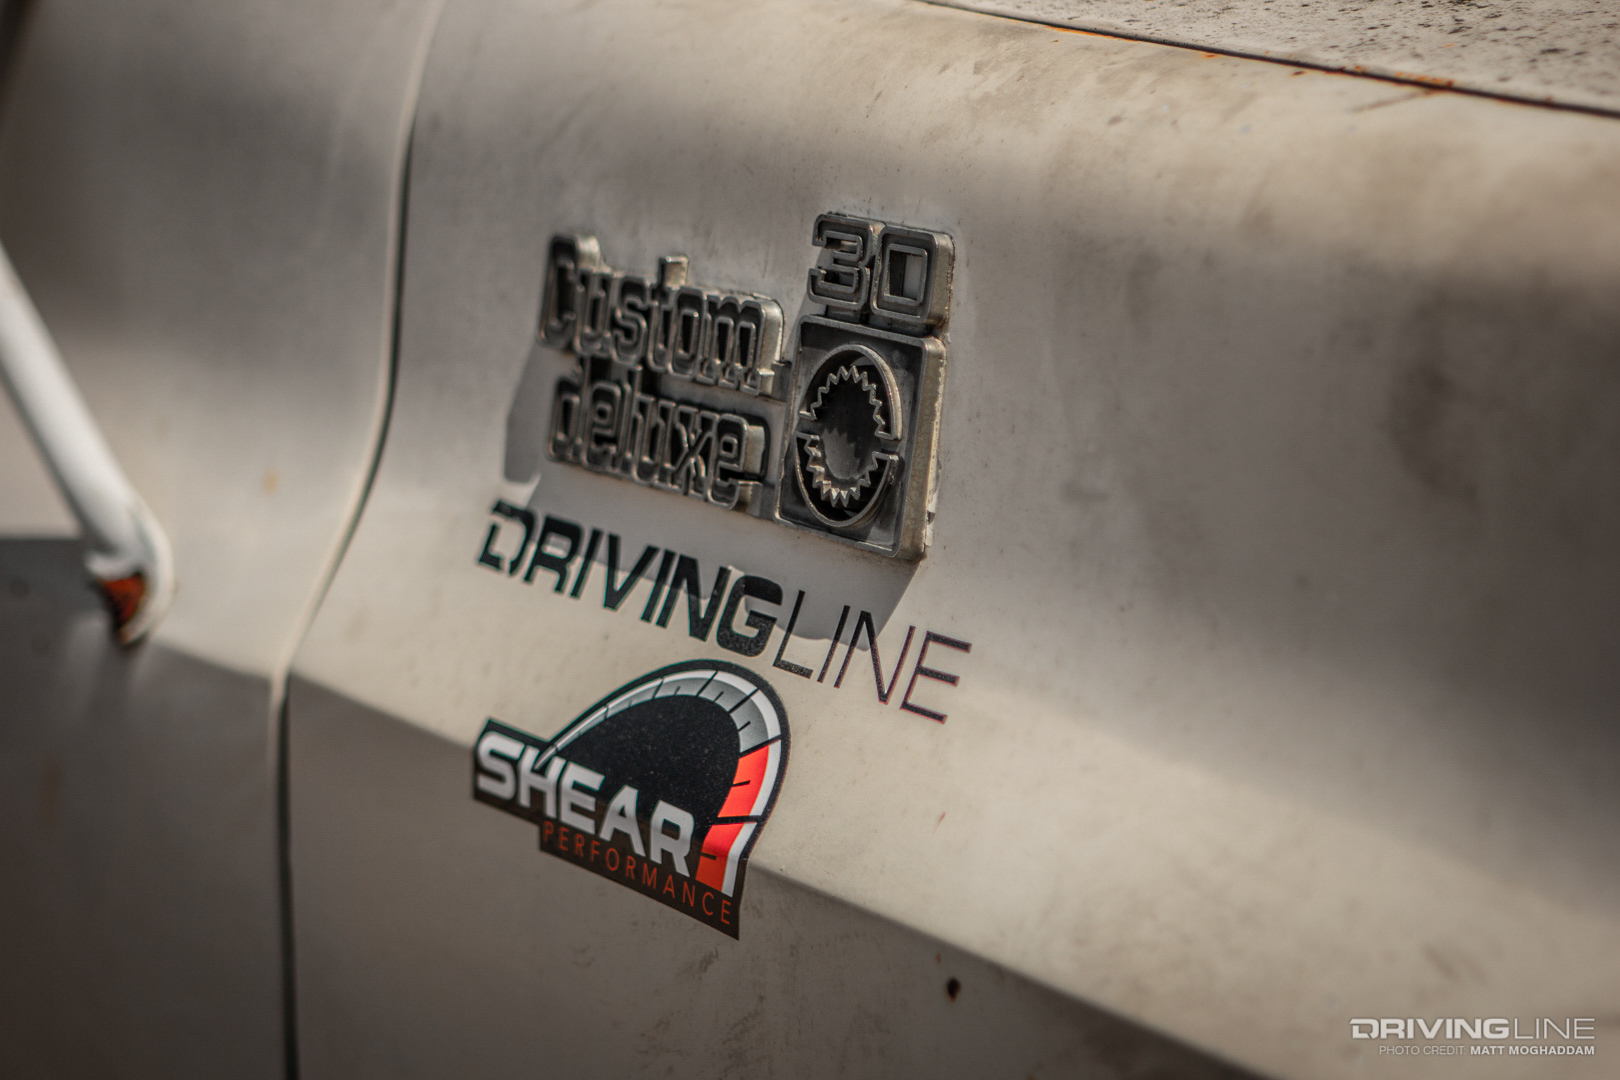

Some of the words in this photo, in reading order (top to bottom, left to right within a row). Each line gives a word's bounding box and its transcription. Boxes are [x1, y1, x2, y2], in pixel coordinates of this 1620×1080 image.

[537, 234, 784, 396] Custom
[808, 214, 954, 325] 30
[545, 355, 769, 509] deluxe
[475, 730, 695, 878] SHEAR
[542, 820, 733, 926] PERFORMANCE
